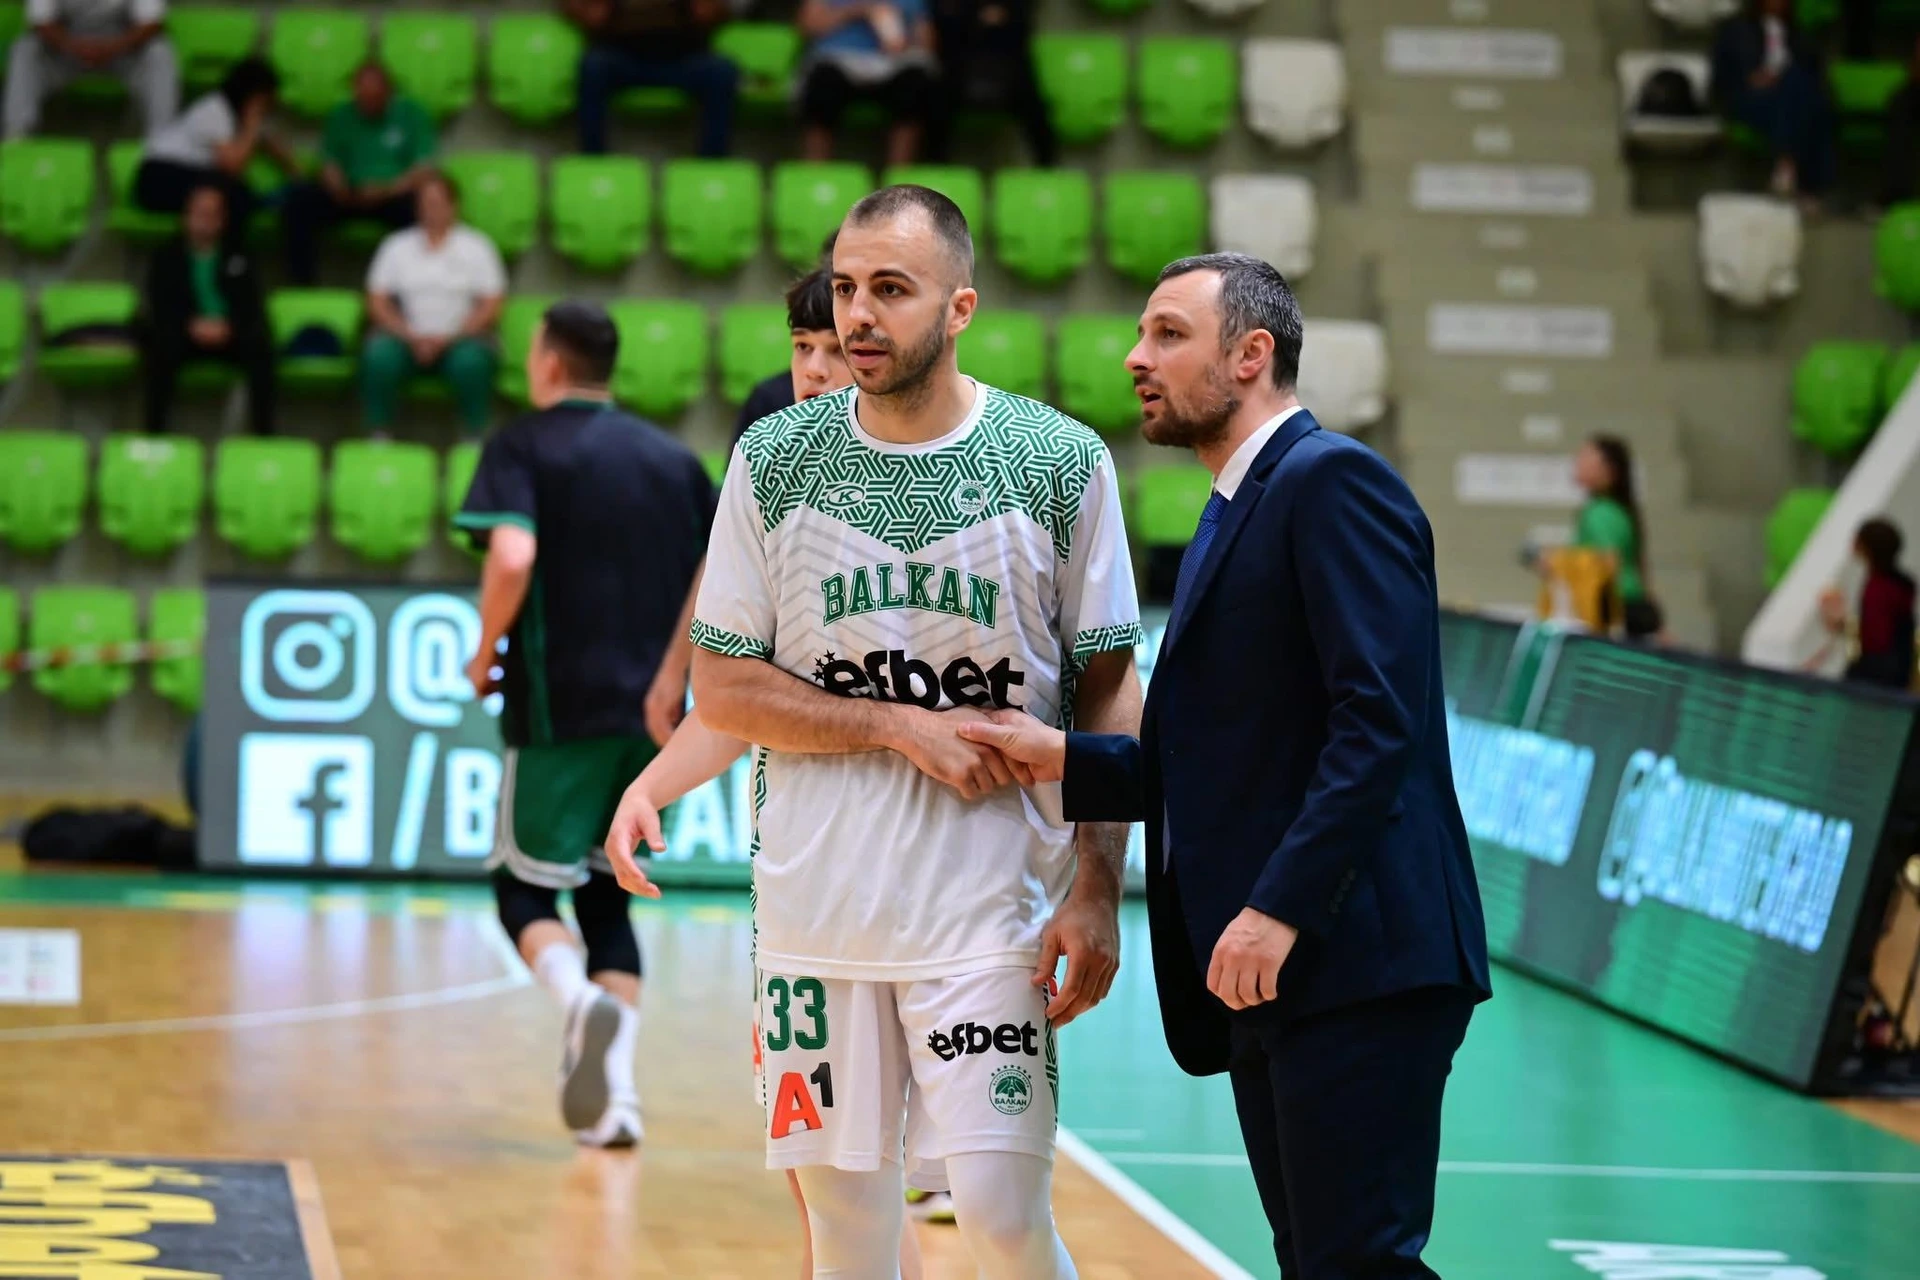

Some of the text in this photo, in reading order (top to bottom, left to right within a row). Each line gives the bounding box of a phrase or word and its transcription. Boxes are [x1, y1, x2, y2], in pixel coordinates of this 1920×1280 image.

[821, 562, 1000, 629] BALKAN
[822, 650, 1025, 712] efbet
[767, 976, 830, 1051] 33
[929, 1021, 1038, 1062] efbet
[771, 1061, 834, 1139] A1
